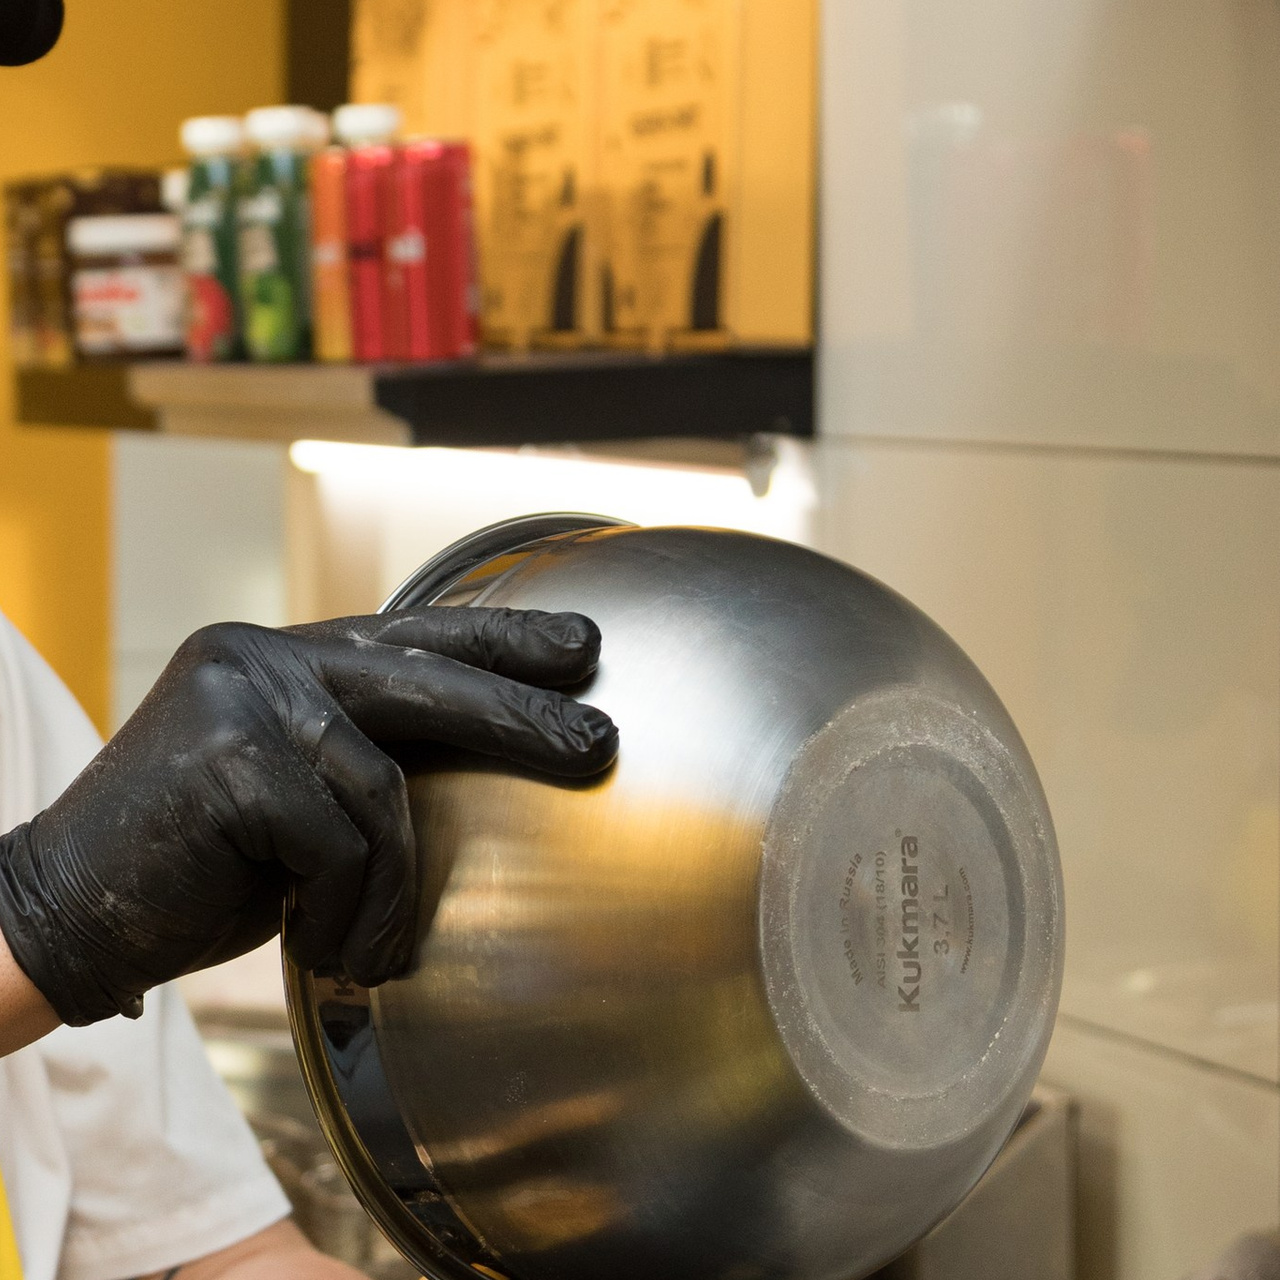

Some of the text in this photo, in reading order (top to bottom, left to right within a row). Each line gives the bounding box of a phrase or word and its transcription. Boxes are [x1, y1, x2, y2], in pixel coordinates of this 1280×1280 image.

[839, 853, 863, 911] Russia
[875, 851, 887, 989] AISI 304 (18/10)
[896, 835, 922, 1012] Kukmara
[933, 884, 951, 955] 3,7 L
[958, 867, 975, 974] www.kukmara.com
[843, 939, 863, 986] Made
